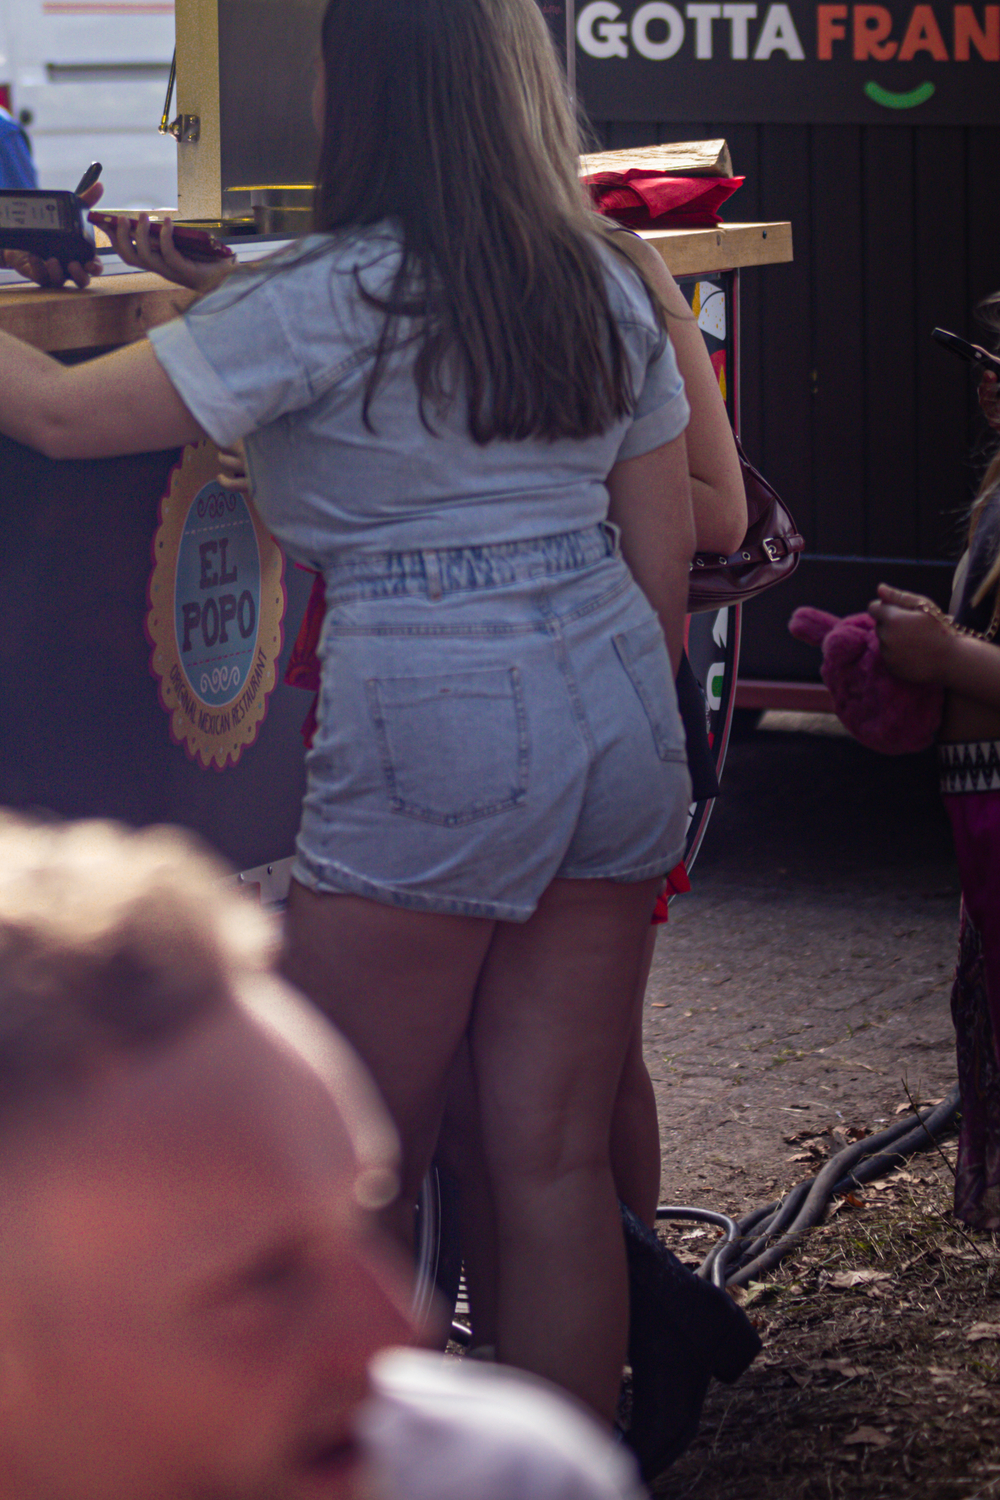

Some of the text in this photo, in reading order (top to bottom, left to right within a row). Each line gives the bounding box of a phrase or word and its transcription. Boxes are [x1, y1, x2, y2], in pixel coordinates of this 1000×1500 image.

[576, 1, 805, 61] GOTTA
[199, 537, 238, 590] EL
[182, 590, 256, 653] POPO
[197, 709, 231, 736] MEXICAN
[231, 646, 267, 728] RESTAURANT
